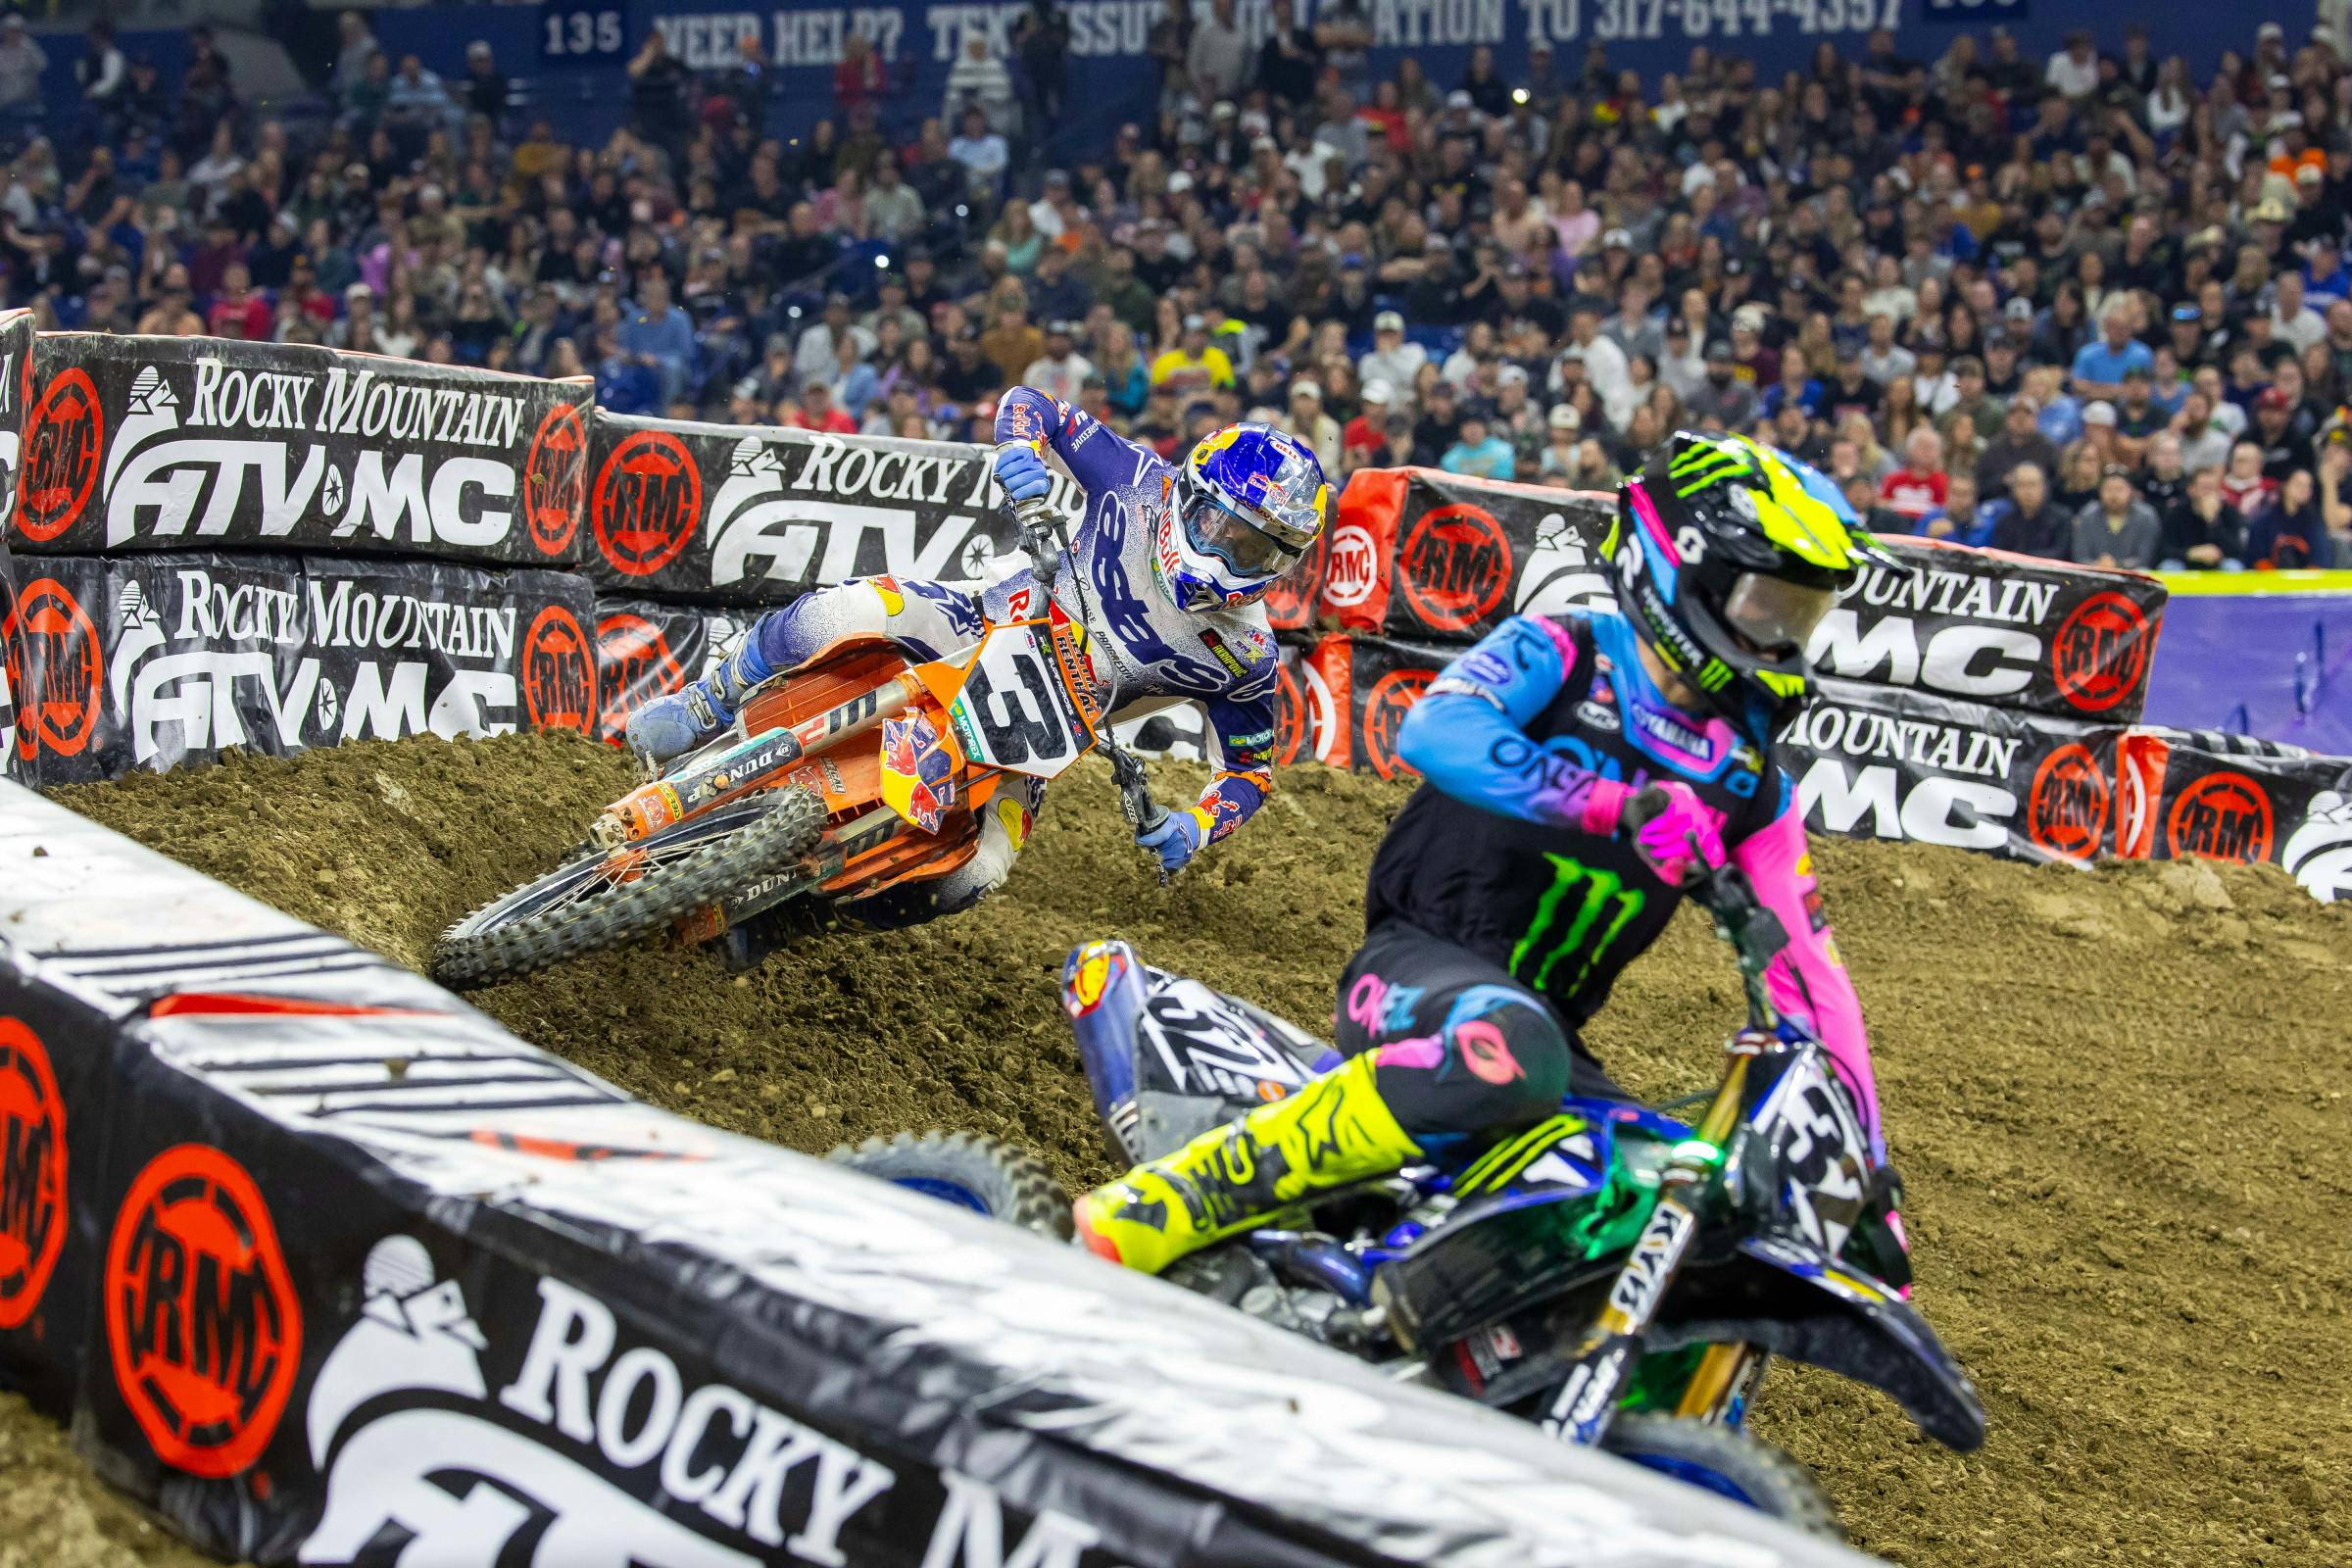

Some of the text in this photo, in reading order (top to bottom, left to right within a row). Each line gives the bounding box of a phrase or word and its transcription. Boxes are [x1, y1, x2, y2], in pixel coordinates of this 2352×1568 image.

[544, 10, 623, 55] 135
[926, 4, 1039, 62] TEX
[1519, 0, 1581, 41] TO
[185, 357, 526, 449] ROCKY MOUNTAIN
[791, 434, 969, 504] ROCKY
[173, 569, 517, 660] ROCKY MOUNTAIN
[1834, 563, 2059, 626] OUNTAIN
[964, 654, 1067, 766] 3
[1055, 635, 1092, 719] RENTHAL
[499, 1276, 896, 1567] ROCKY
